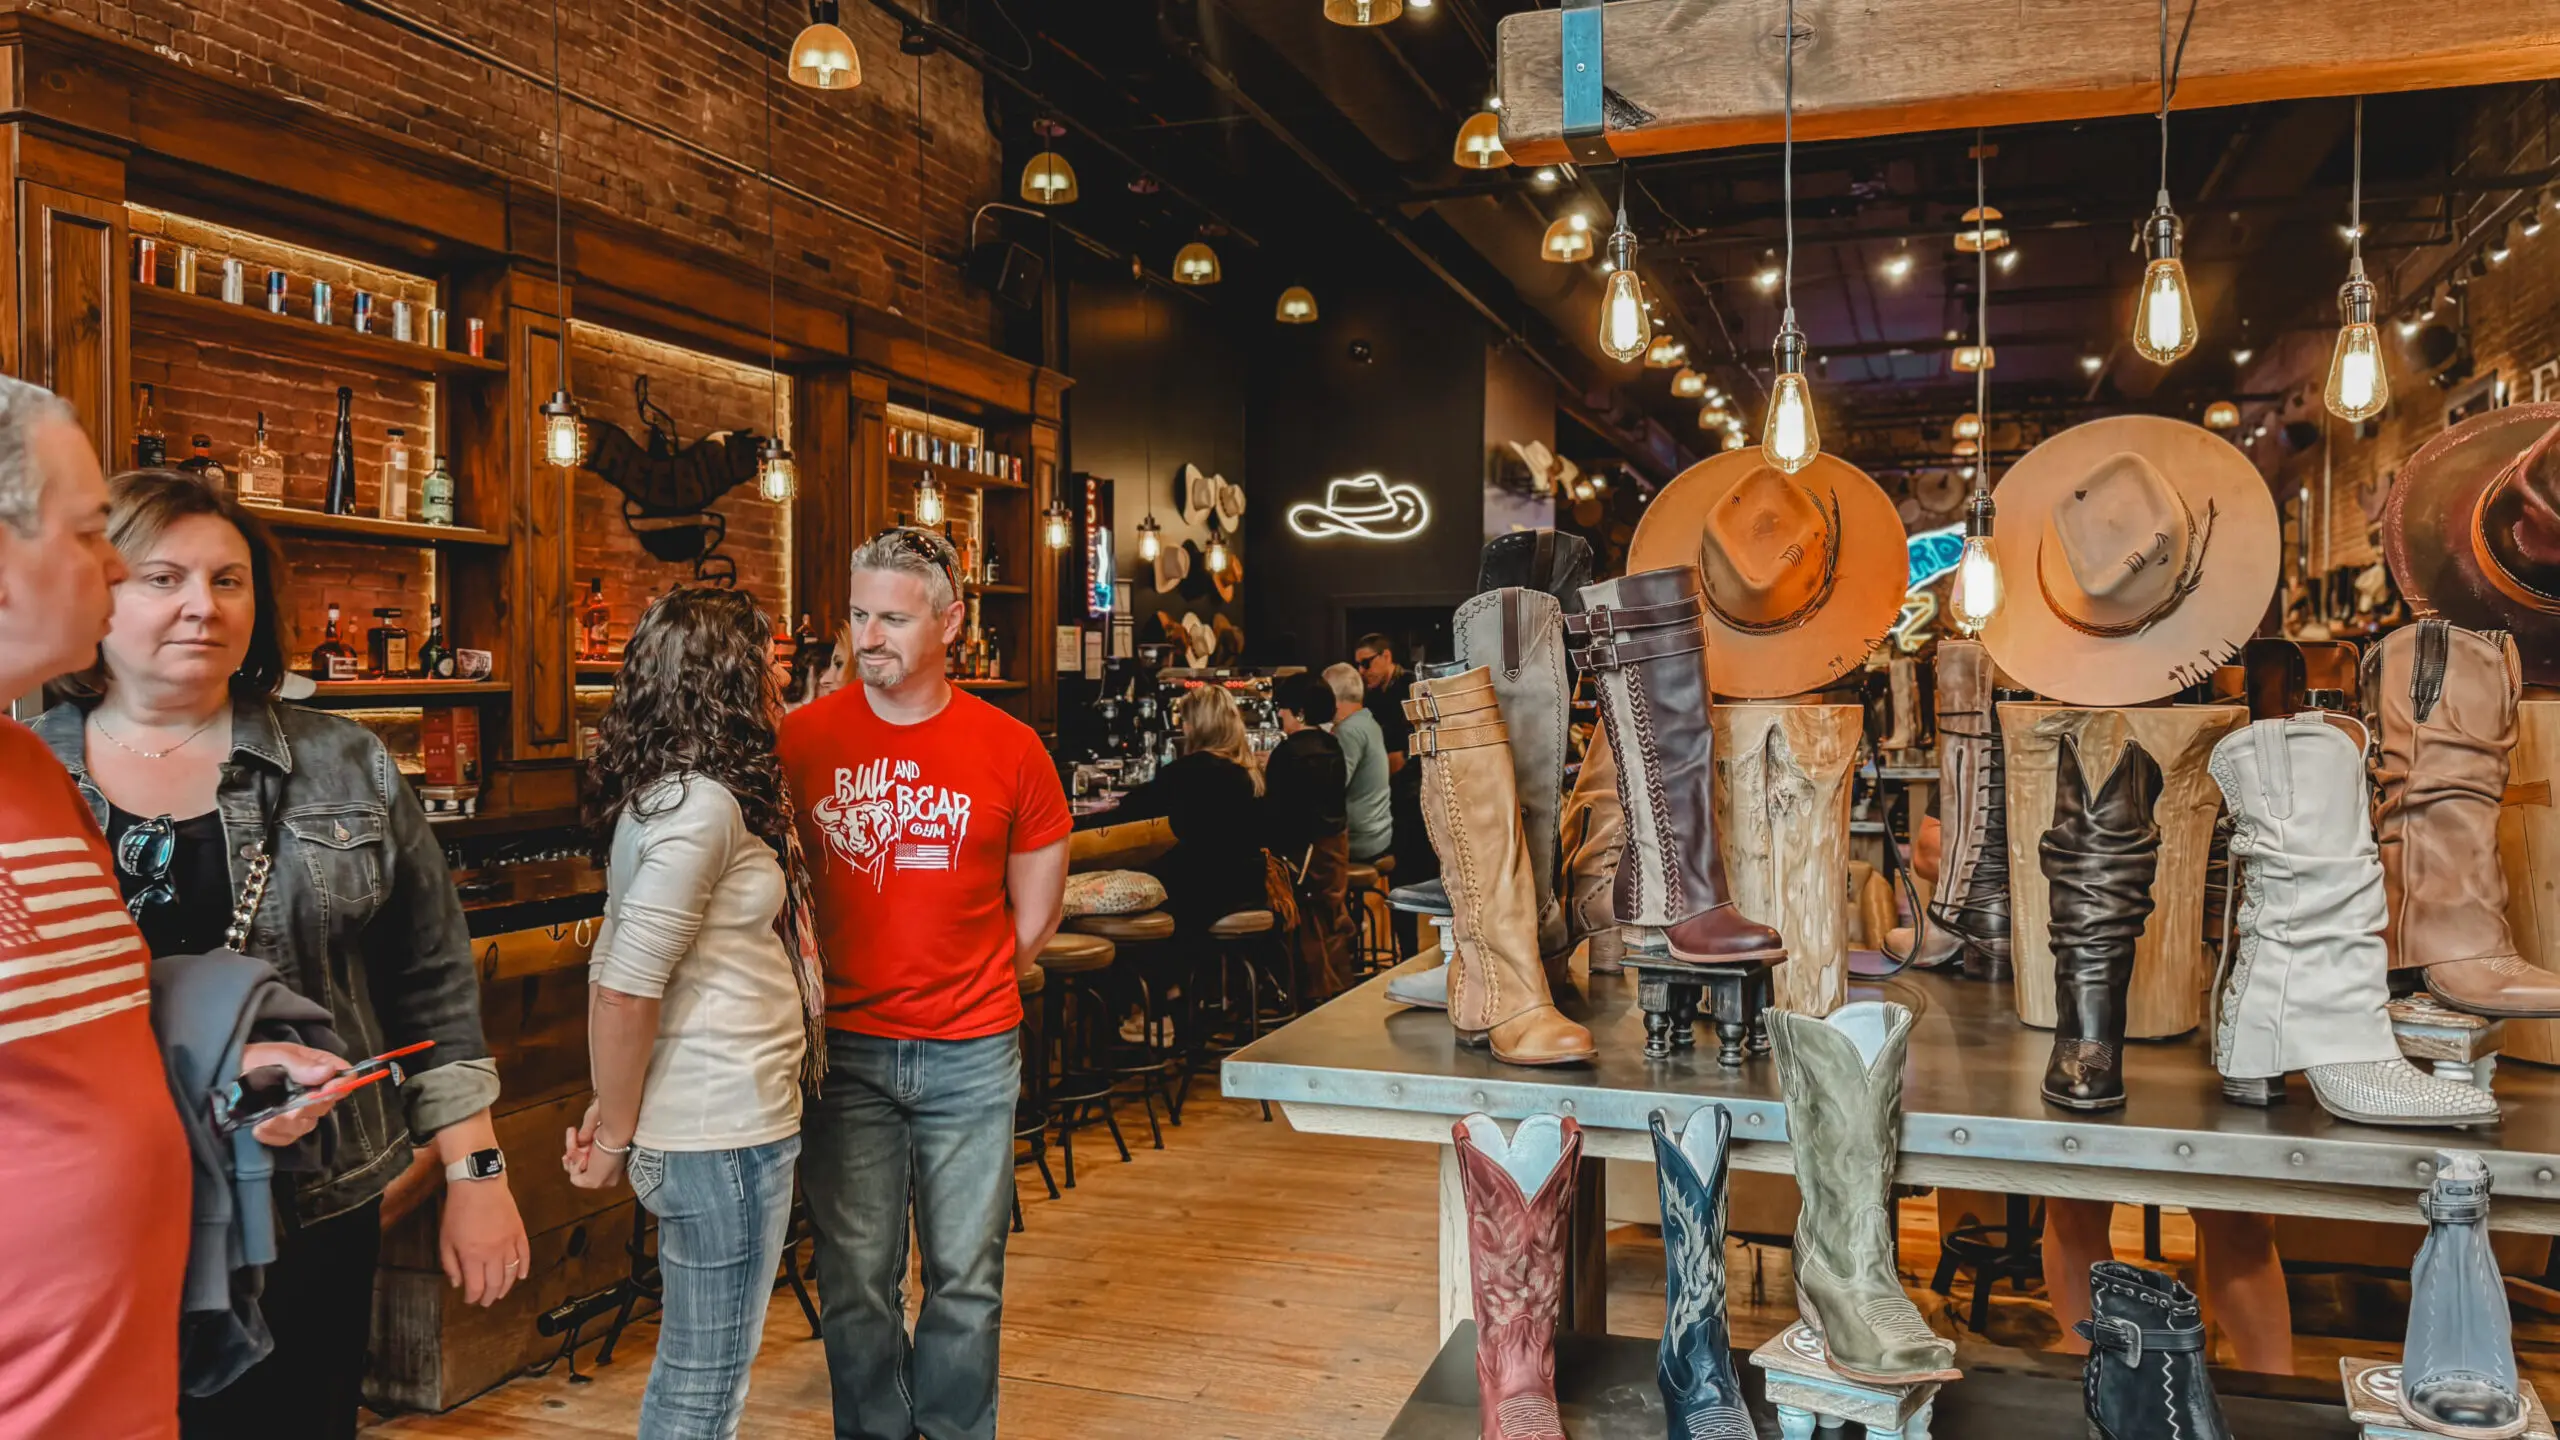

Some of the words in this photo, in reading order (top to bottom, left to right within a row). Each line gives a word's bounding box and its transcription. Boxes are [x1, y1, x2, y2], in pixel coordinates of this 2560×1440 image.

[835, 757, 895, 805] BULL
[893, 760, 920, 782] AND
[896, 785, 971, 836] BEAR
